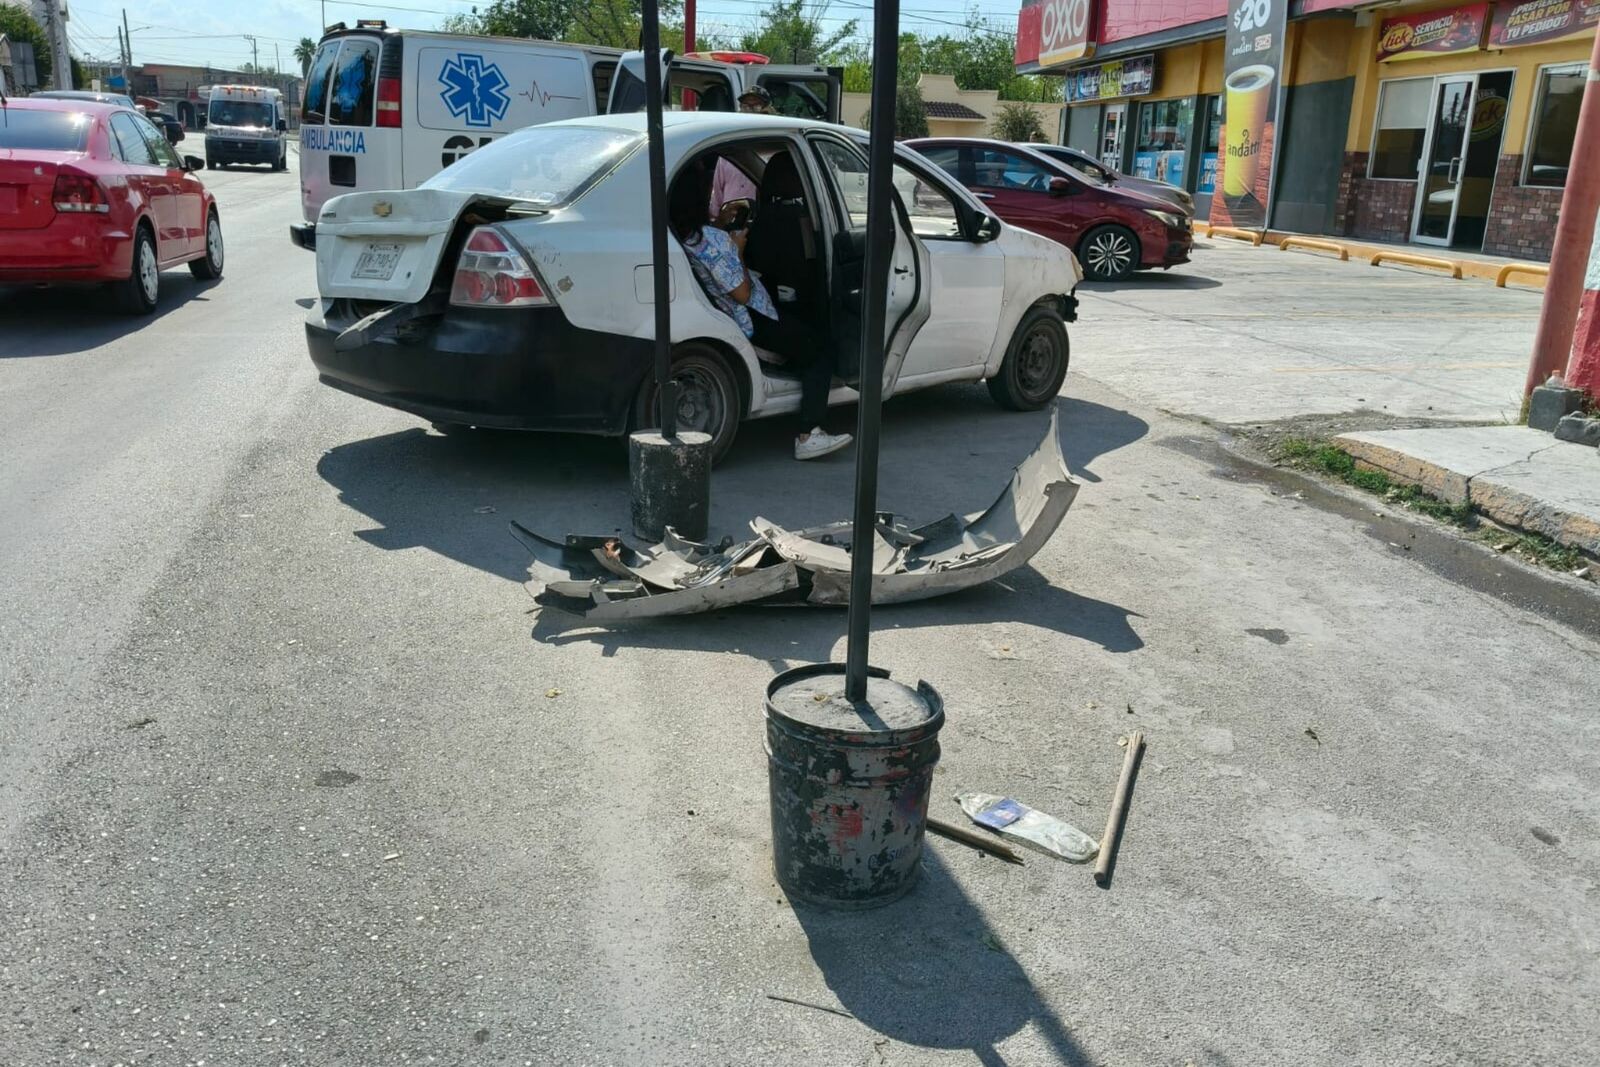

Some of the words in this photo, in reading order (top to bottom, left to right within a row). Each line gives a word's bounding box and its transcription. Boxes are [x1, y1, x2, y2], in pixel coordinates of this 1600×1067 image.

[1042, 0, 1088, 50] OXXO
[1233, 0, 1271, 32] $20
[1414, 14, 1454, 35] SERVICIO
[1506, 9, 1545, 28] PASAR
[1545, 1, 1571, 17] POR
[1506, 28, 1521, 39] TU
[1521, 14, 1569, 35] PEDIDO?
[302, 128, 367, 154] AMBULANCIA
